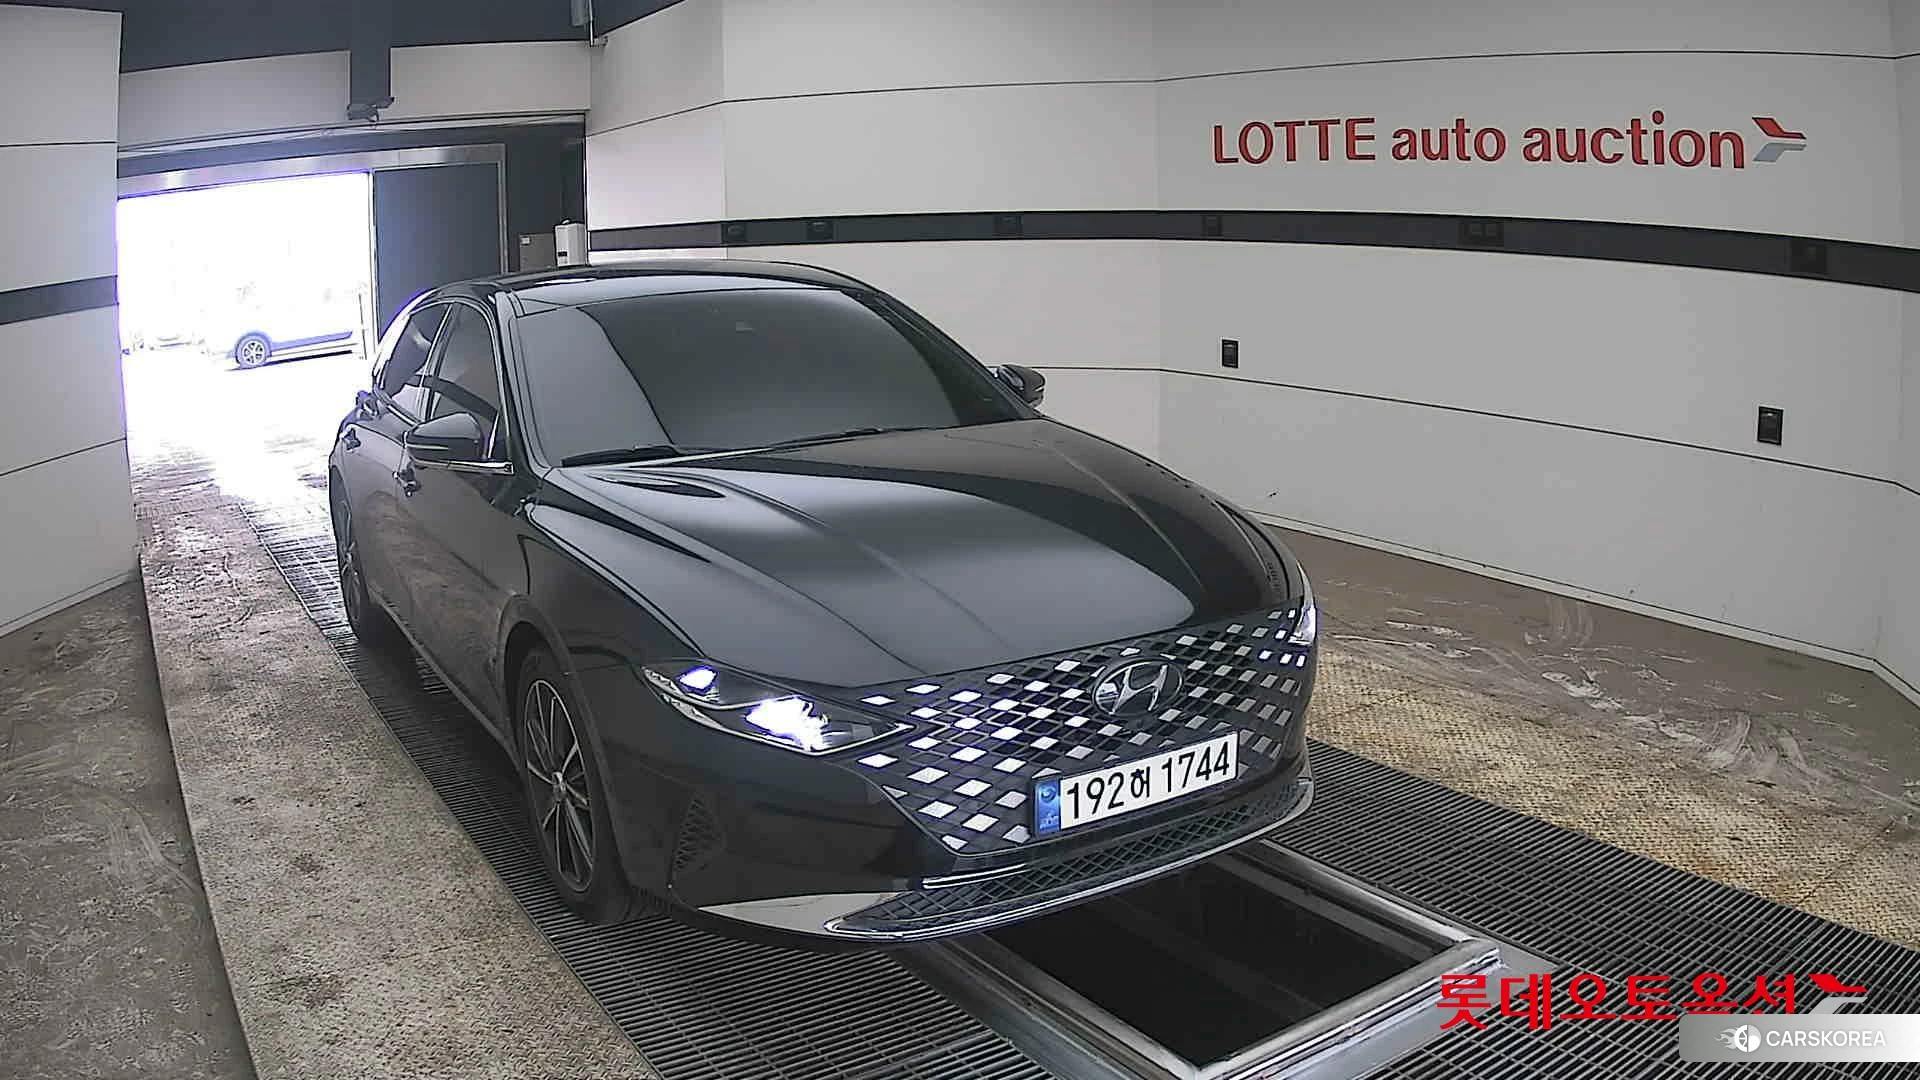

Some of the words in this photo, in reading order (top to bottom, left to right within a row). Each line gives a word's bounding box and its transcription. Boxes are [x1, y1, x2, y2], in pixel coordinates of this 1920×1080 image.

[1213, 117, 1376, 164] LOTTE
[1391, 117, 1507, 162] auto
[1522, 110, 1746, 169] auction
[1066, 765, 1151, 820] 192허
[1161, 741, 1230, 793] 1744
